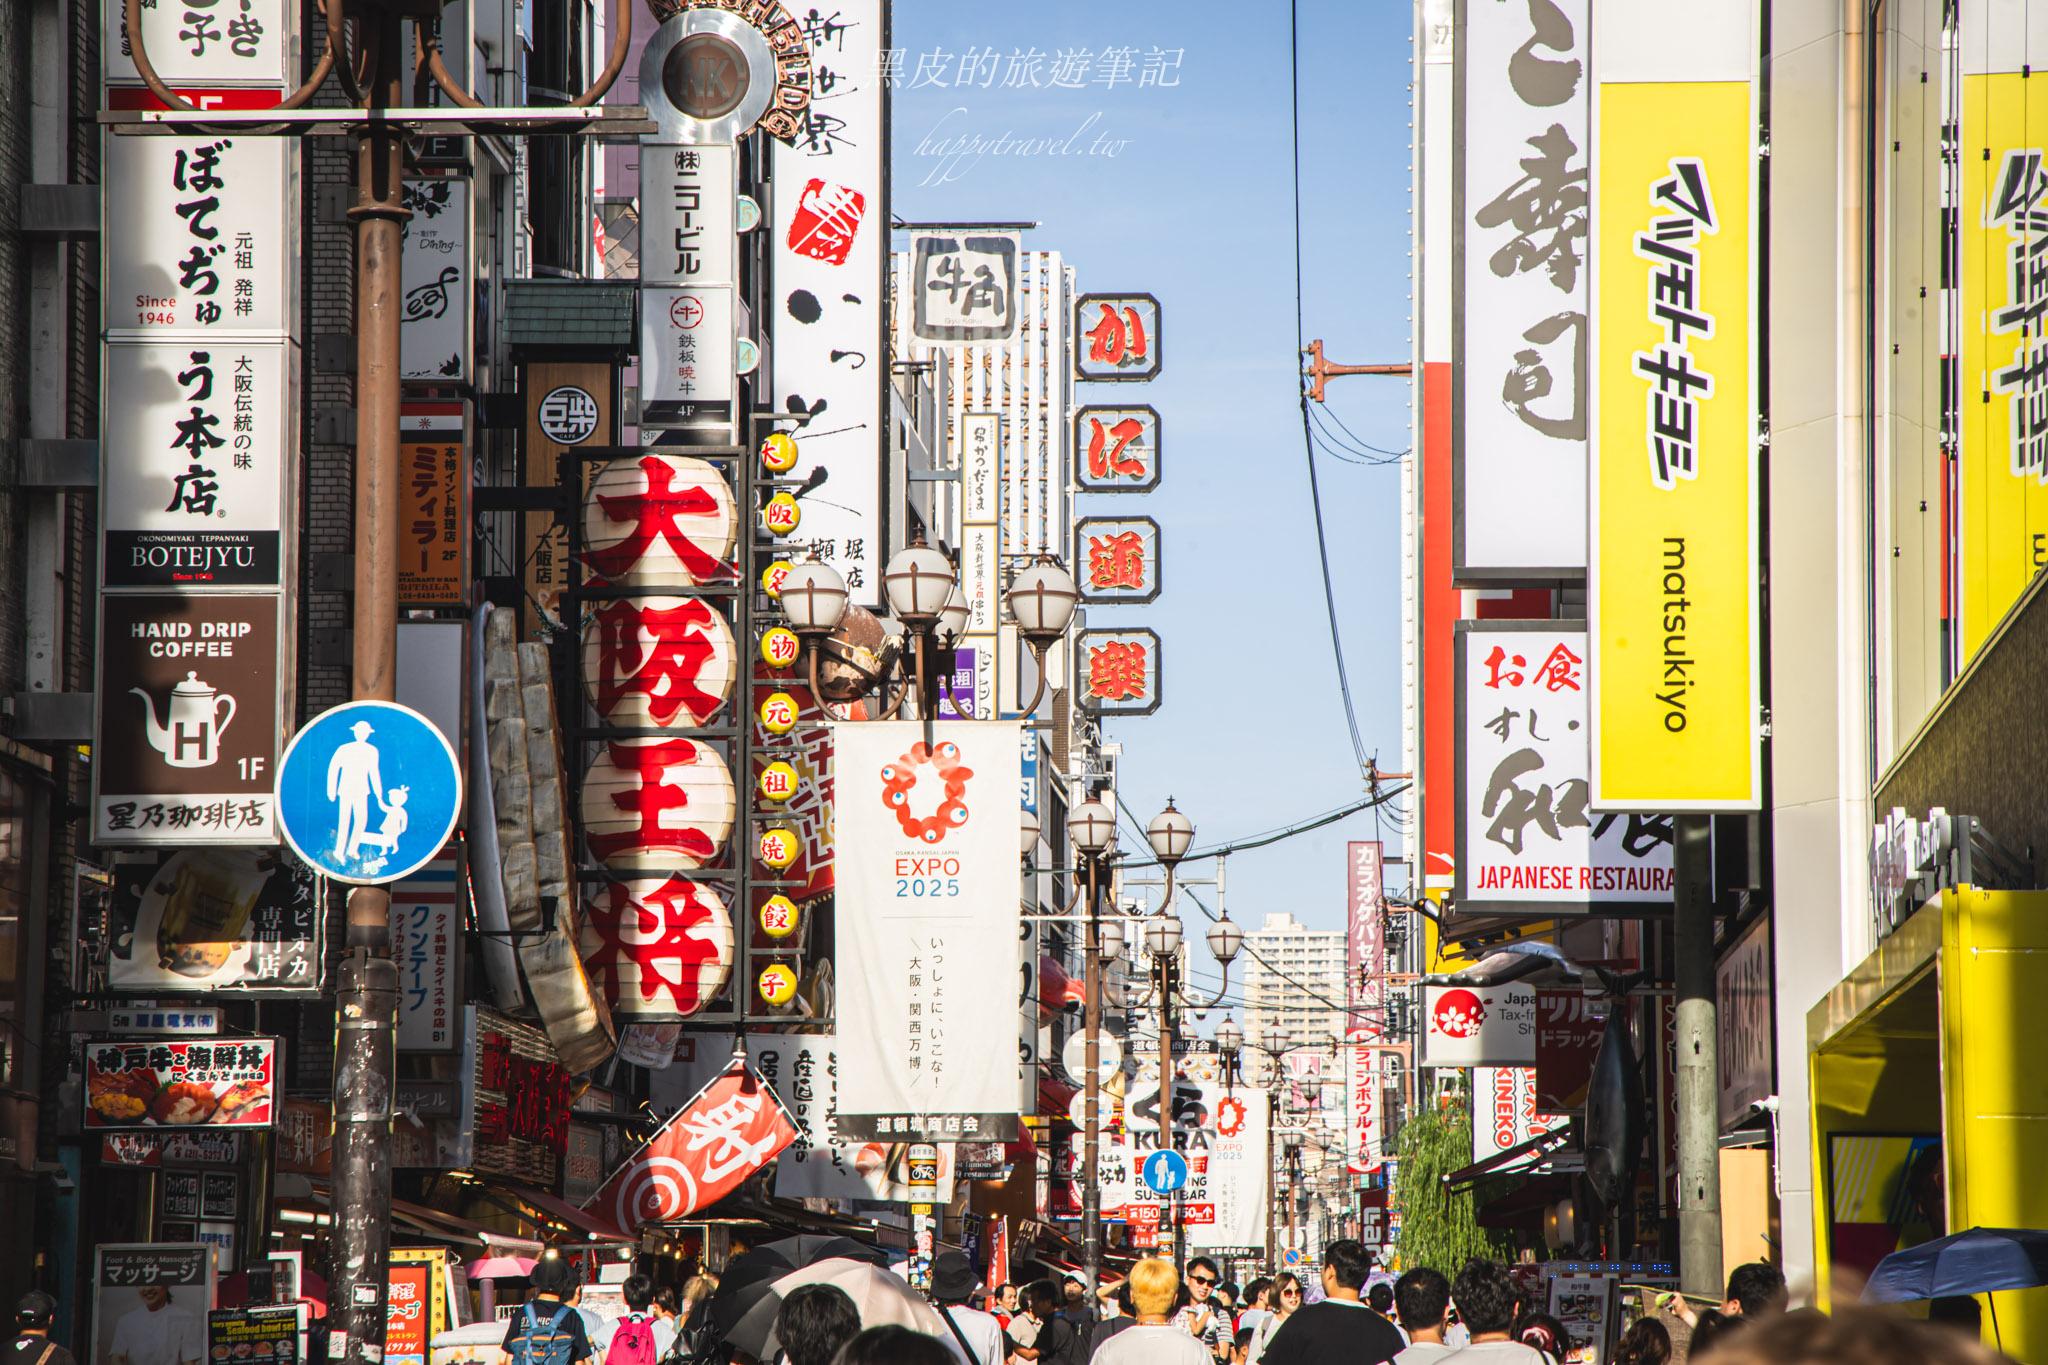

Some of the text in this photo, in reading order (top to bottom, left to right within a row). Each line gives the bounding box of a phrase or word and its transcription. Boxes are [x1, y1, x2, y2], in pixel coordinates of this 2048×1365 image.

[419, 238, 455, 253] Dining
[234, 232, 253, 317] 元祖 発祥
[927, 256, 1004, 316] 牛角
[136, 295, 176, 308] Since
[137, 312, 175, 325] 1946
[1638, 162, 1713, 483] マツモトキヨシ
[233, 355, 253, 470] 大阪伝統の味
[677, 404, 695, 417] 4F
[412, 447, 438, 572] ミティラー
[131, 546, 255, 571] BOTEJYU
[442, 550, 457, 561] 2F
[131, 623, 251, 638] HAND DRIP
[1656, 537, 1694, 733] matsukiyo
[150, 642, 233, 657] COFFEE
[174, 722, 208, 760] H
[579, 455, 743, 1015] 大阪王将
[237, 758, 265, 780] 1F
[107, 799, 266, 832] 星乃珈琲店
[895, 858, 960, 876] EXPO
[896, 879, 960, 897] 2025
[1477, 866, 1573, 890] JAPANESE
[256, 906, 281, 978] 専門店
[408, 906, 430, 1012] クンテープ
[909, 956, 922, 1070] 大阪・関西万博
[1133, 1041, 1211, 1052] 道頓商店会
[97, 1046, 264, 1073] 神戸牛と海鮮丼
[877, 1117, 979, 1133] 道頓堀商店会
[1216, 1143, 1243, 1151] EXPO
[1216, 1152, 1243, 1160] 2025
[964, 1170, 1002, 1178] restaurant
[1181, 1190, 1206, 1200] BAR
[105, 1256, 124, 1264] Foot
[137, 1256, 156, 1265] Body
[159, 1256, 191, 1264] Massage
[105, 1263, 198, 1283] マッサージ
